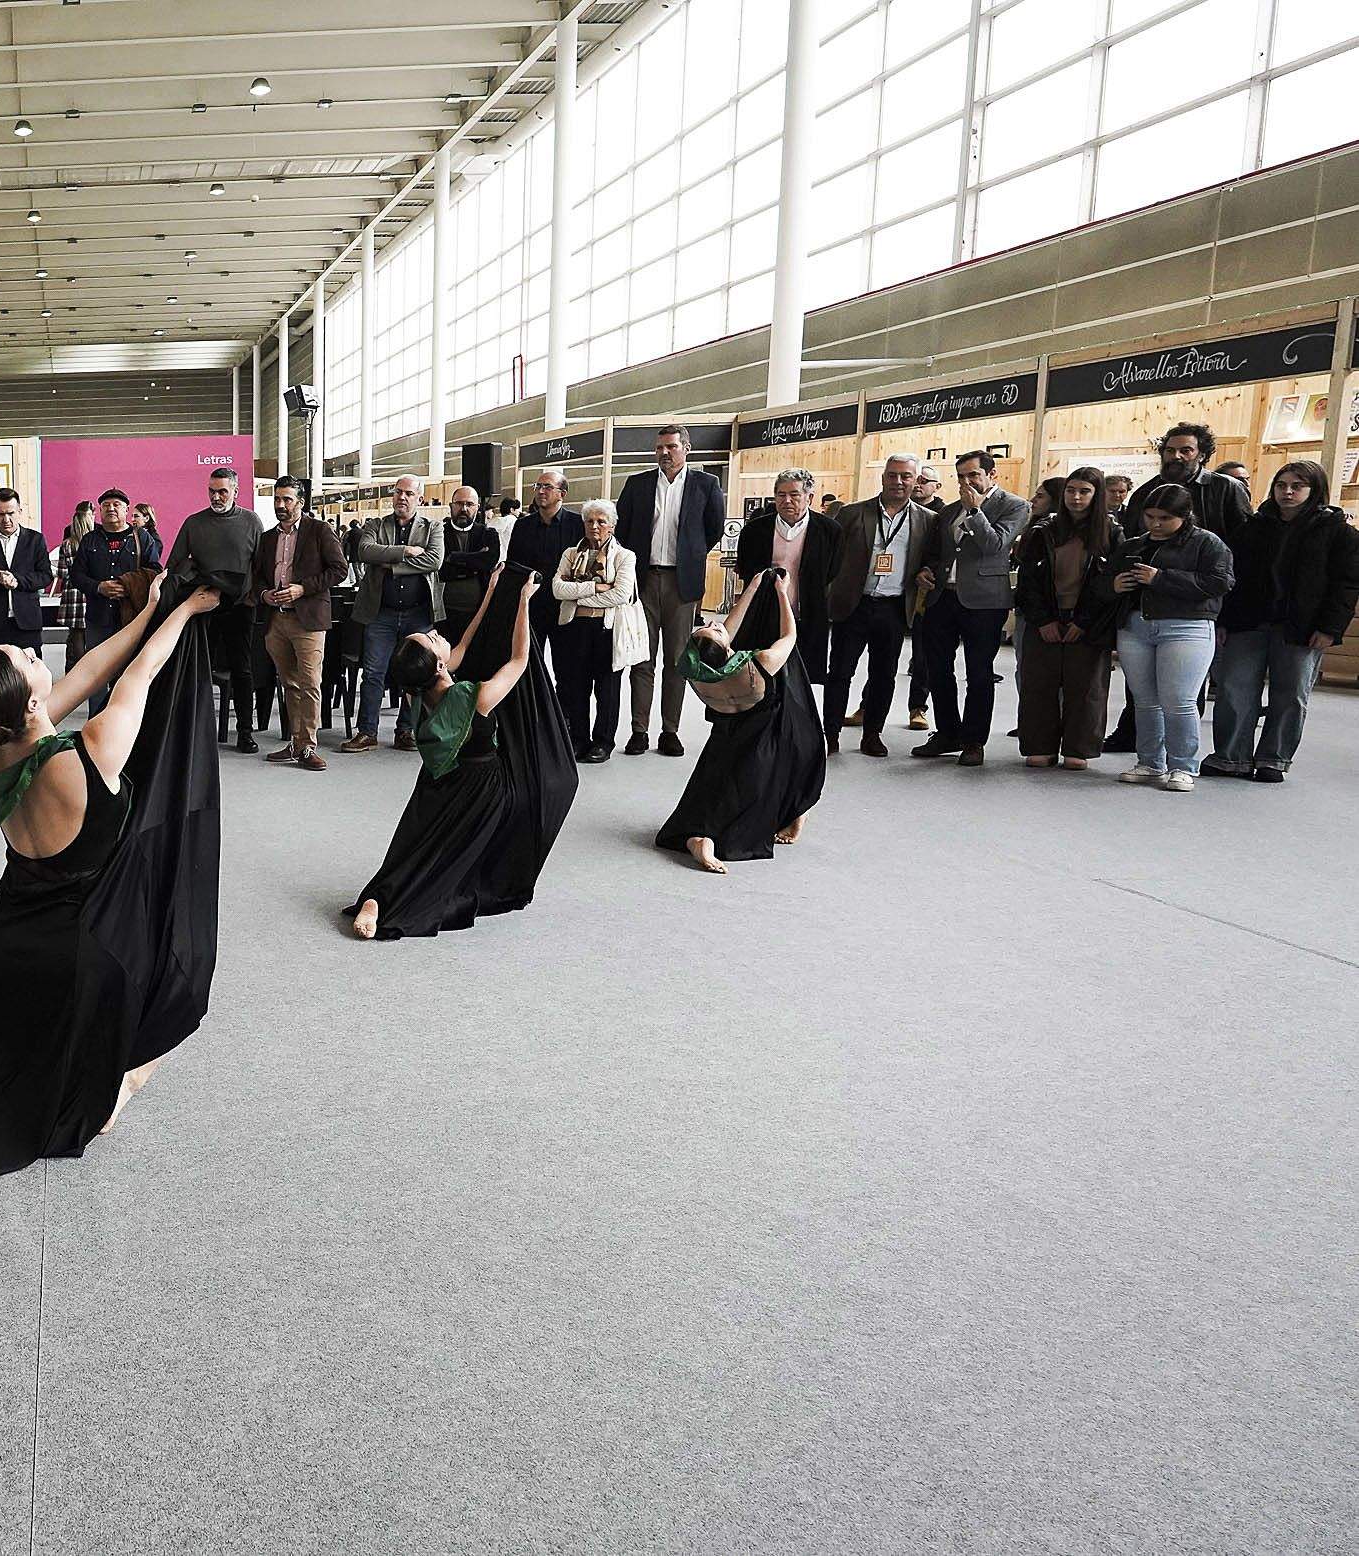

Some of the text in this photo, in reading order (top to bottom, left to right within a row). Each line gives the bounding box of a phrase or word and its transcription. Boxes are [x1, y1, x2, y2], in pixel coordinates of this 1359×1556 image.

[1103, 347, 1248, 393] Alvarellos Editora
[983, 391, 997, 405] en
[1001, 383, 1019, 406] 3D
[197, 454, 233, 465] Letras
